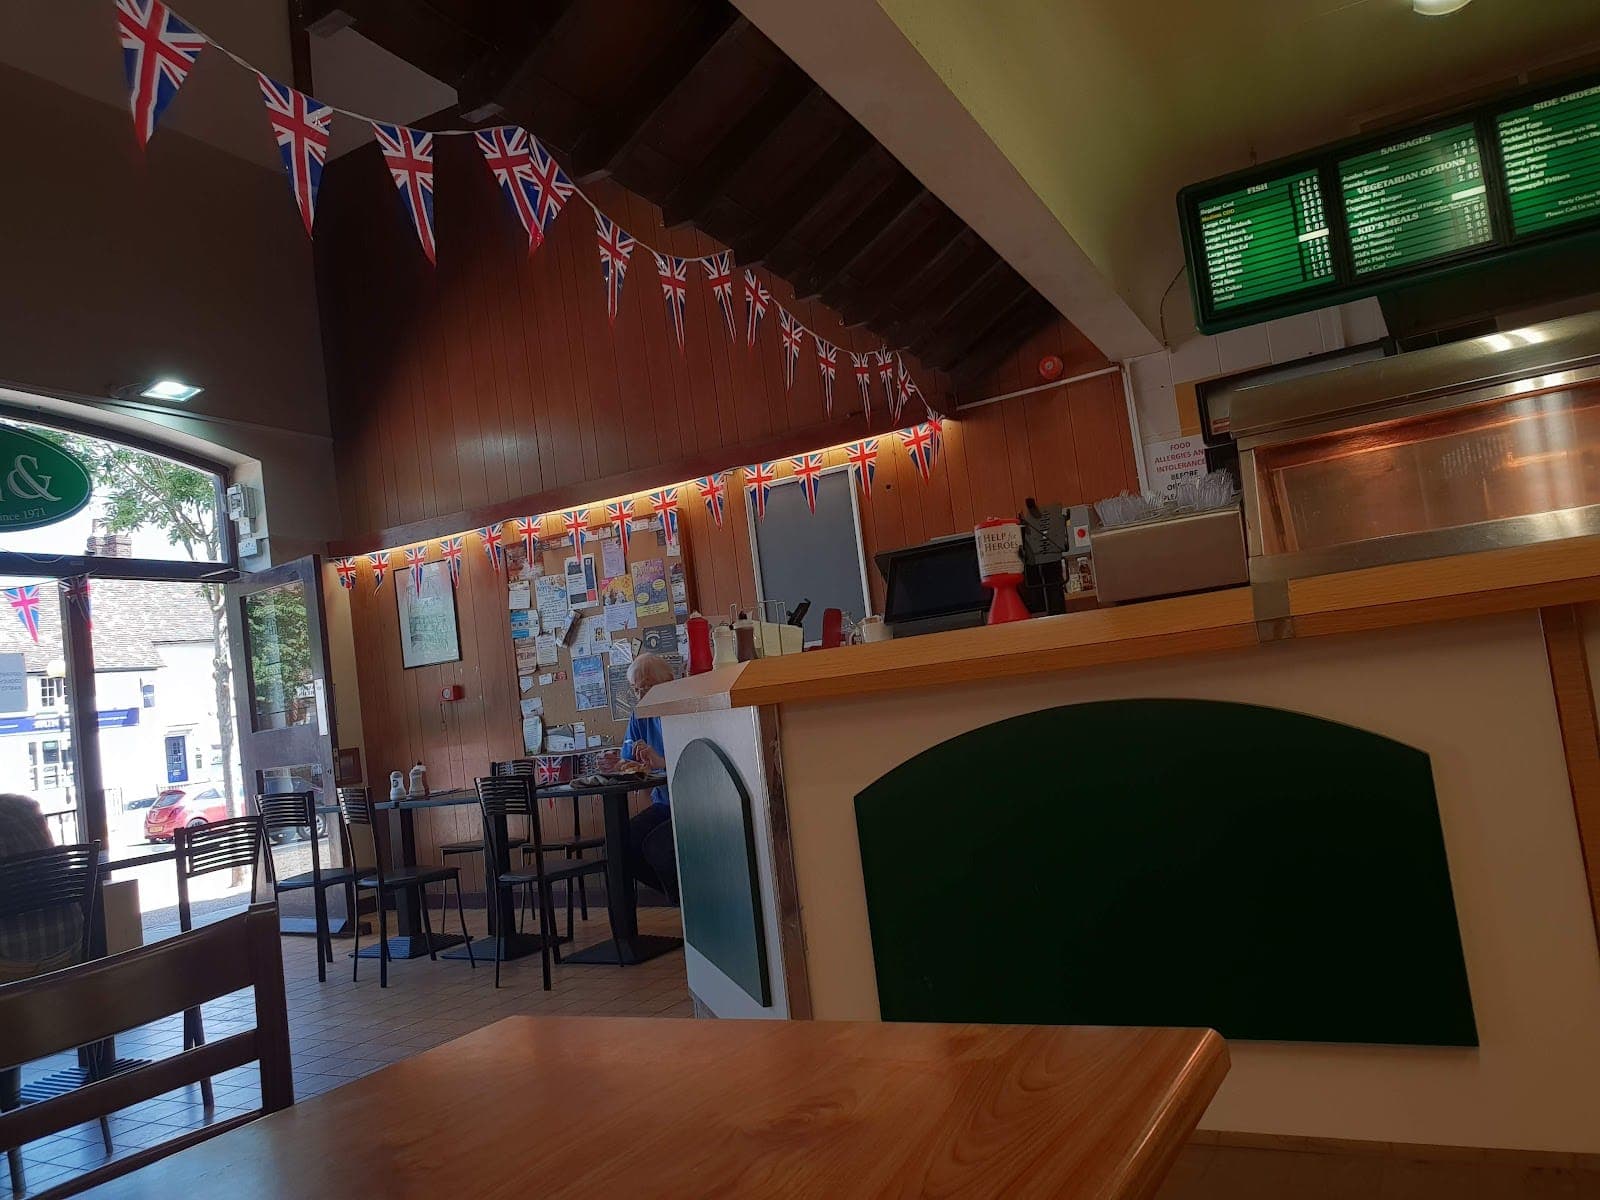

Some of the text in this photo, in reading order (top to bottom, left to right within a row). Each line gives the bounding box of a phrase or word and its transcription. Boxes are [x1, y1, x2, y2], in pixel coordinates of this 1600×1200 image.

[1533, 86, 1600, 111] SIDE ORDER
[1381, 135, 1432, 155] SAUSAGES
[1357, 157, 1466, 194] VEGETARIAN OPTIONS
[1247, 183, 1268, 195] FISH
[1357, 212, 1419, 234] KID'S MEALS
[1170, 441, 1191, 451] FOOD
[1154, 451, 1192, 464] ALLERGIES
[1156, 459, 1205, 473] INTOLERANCE
[7, 455, 62, 501] &
[24, 507, 46, 519] 1971
[984, 532, 1006, 543] HELP
